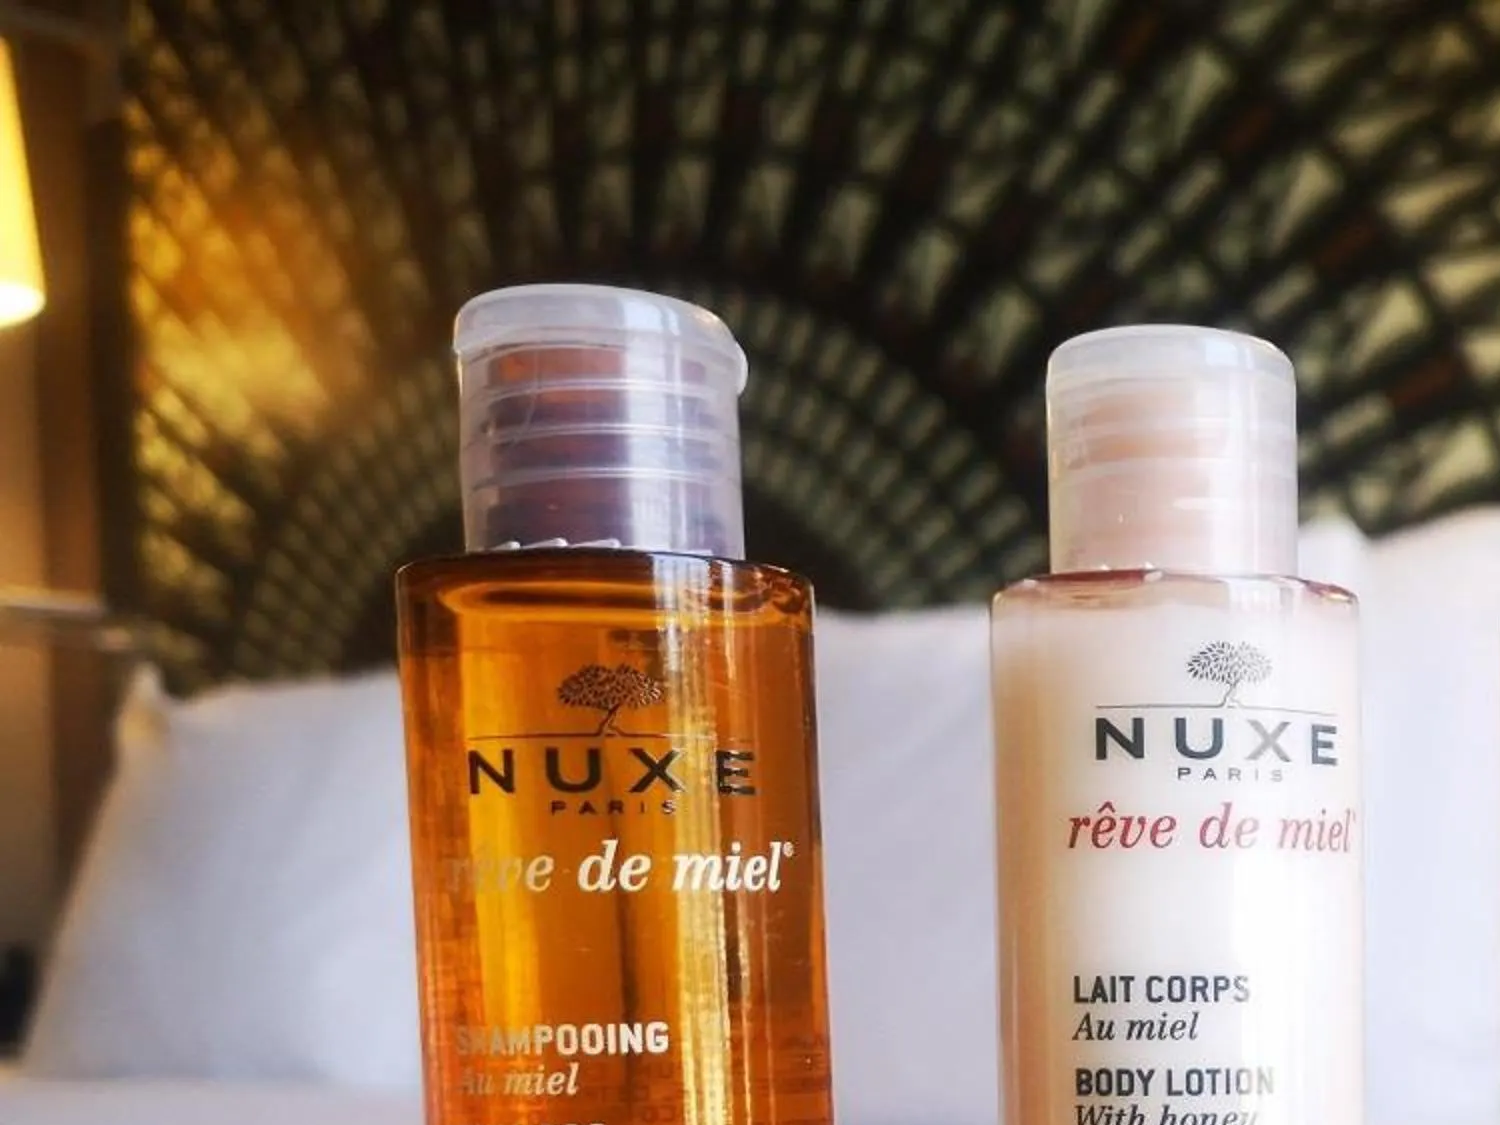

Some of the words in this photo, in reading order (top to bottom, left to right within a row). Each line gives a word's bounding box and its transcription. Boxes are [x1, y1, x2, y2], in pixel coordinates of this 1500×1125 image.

[1094, 717, 1338, 766] NUXE
[467, 747, 756, 796] NUXE
[1177, 767, 1283, 783] PARIS
[551, 800, 678, 815] PARIS
[1068, 801, 1177, 850] rêve
[1200, 802, 1261, 850] de
[578, 839, 651, 891] de
[1073, 975, 1136, 1004] LAIT
[1145, 975, 1251, 1003] CORPS
[457, 1021, 669, 1056] SHAMPOOING
[1072, 1013, 1115, 1041] Au
[1125, 1011, 1200, 1041] miel
[503, 1062, 580, 1096] miel
[1075, 1068, 1155, 1097] BODY
[1166, 1067, 1275, 1096] LOTION
